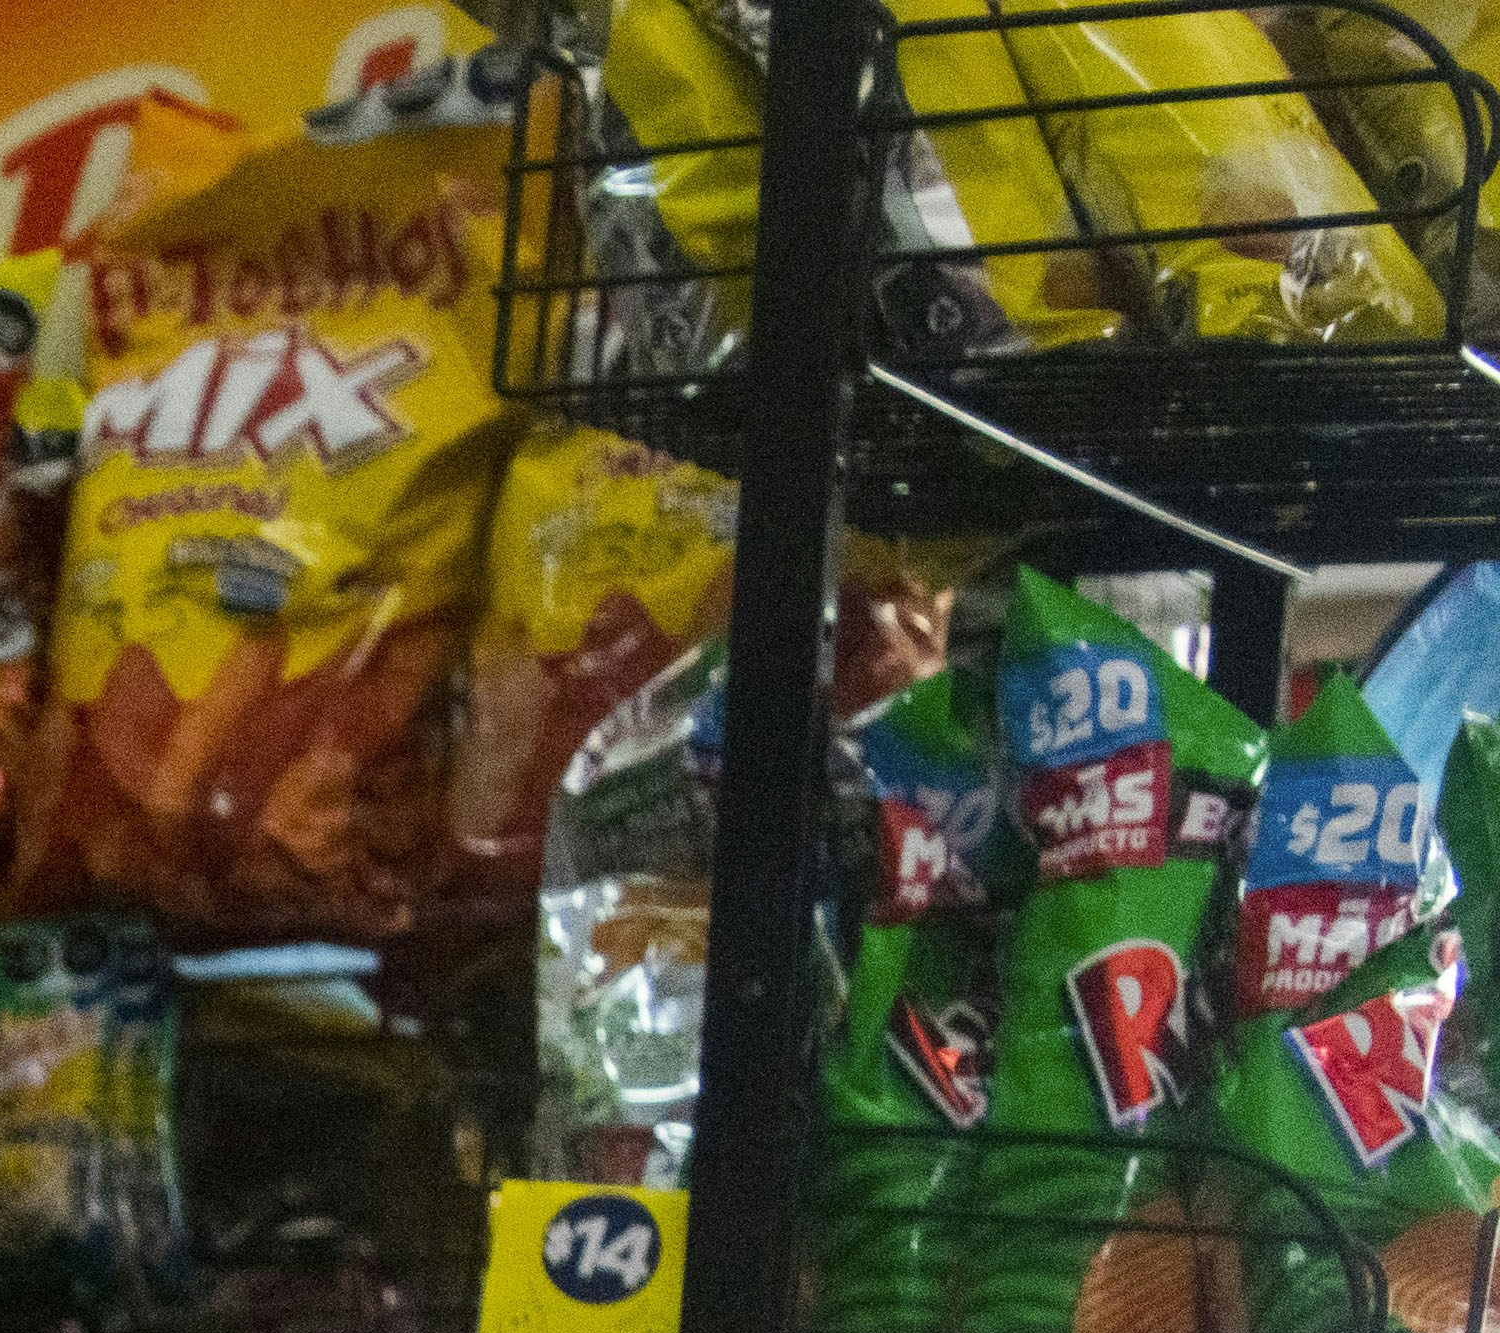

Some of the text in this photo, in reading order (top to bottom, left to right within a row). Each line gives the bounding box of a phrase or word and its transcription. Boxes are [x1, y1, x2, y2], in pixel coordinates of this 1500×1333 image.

[86, 328, 422, 460] MIX
[1028, 656, 1152, 755] $20
[1289, 782, 1427, 866] $20
[543, 1220, 654, 1286] $14
